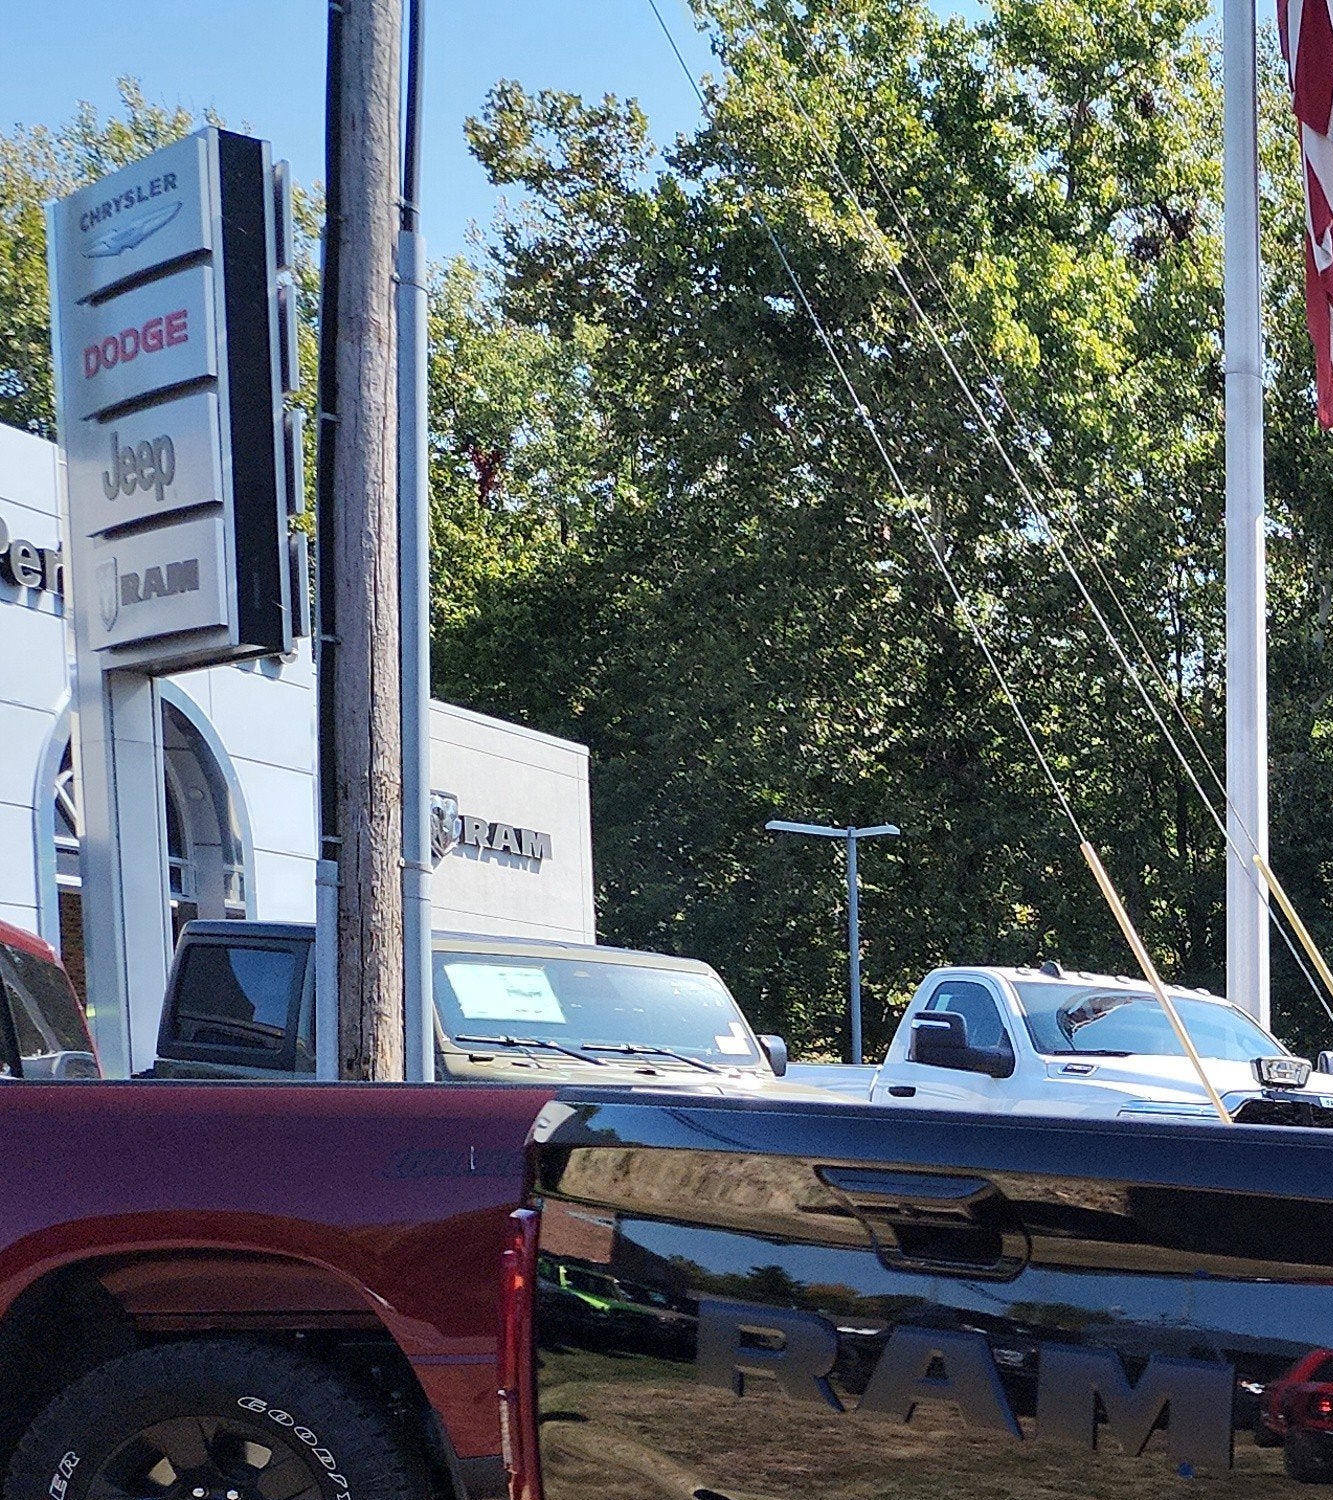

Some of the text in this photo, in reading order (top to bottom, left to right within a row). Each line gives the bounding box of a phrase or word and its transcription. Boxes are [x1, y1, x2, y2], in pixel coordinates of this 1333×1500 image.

[80, 171, 178, 233] CHRYSLER
[83, 308, 189, 380] DODGE
[102, 430, 175, 502] Jeep
[120, 558, 200, 607] RAM
[458, 814, 553, 860] RAM
[695, 1300, 1236, 1472] RAM
